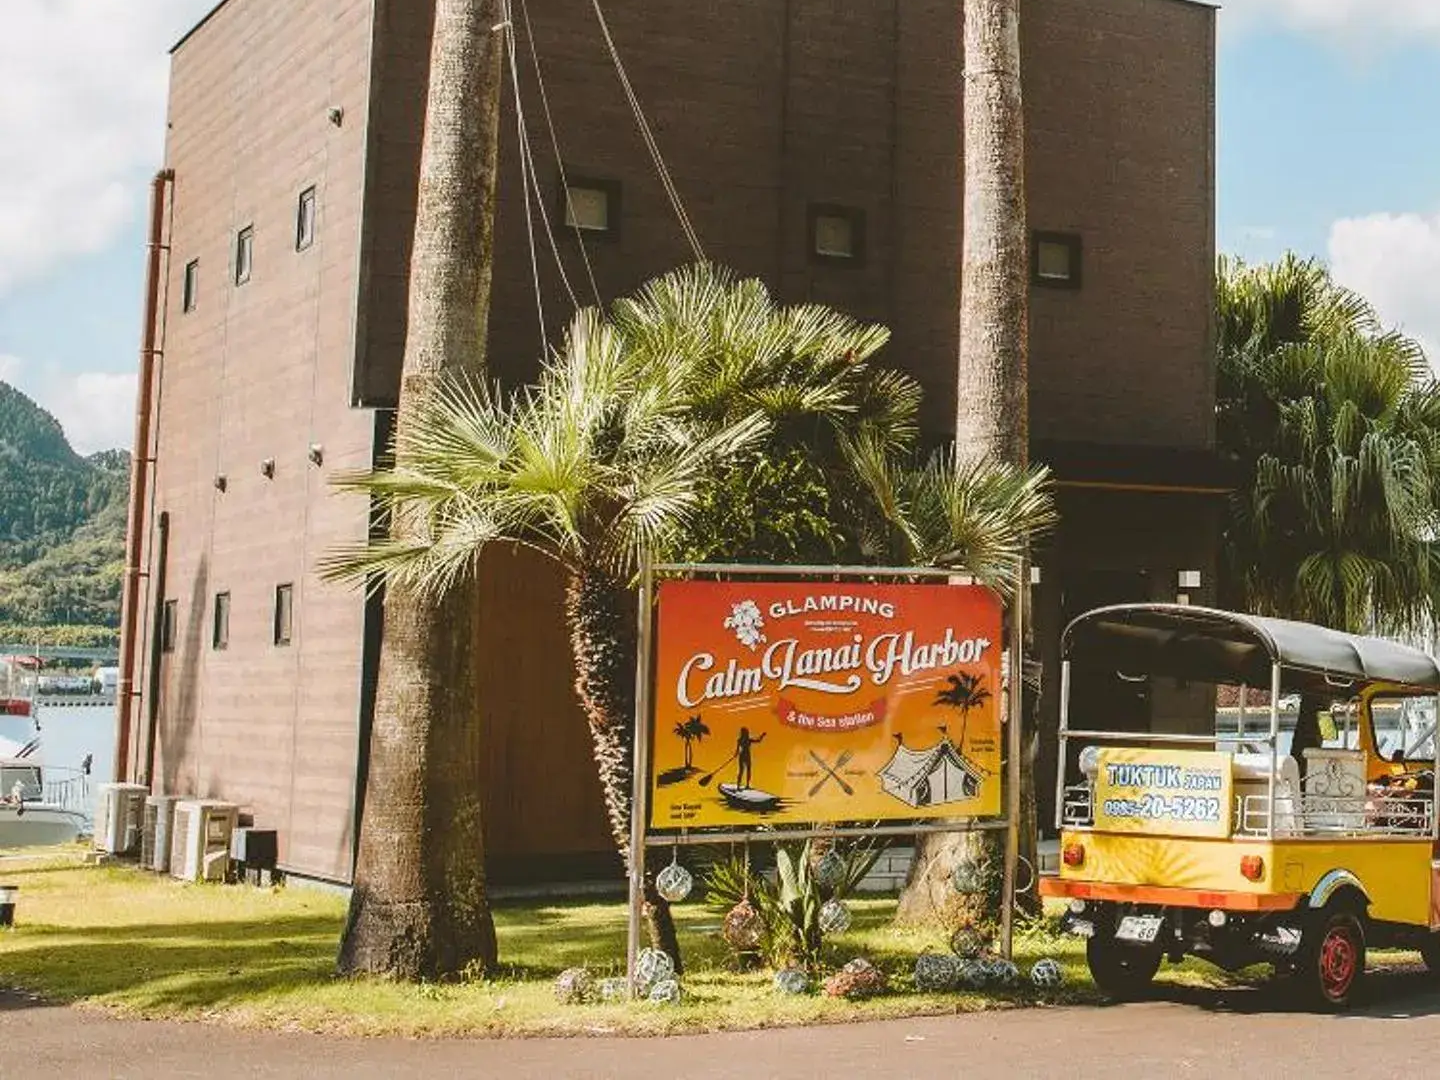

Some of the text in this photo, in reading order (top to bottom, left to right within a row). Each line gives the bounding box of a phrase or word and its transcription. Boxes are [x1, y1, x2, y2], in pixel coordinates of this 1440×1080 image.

[769, 595, 895, 618] GLAMPING
[676, 628, 992, 707] Calm Lanai Harbor
[1106, 762, 1222, 791] TUKTUK JAPAN
